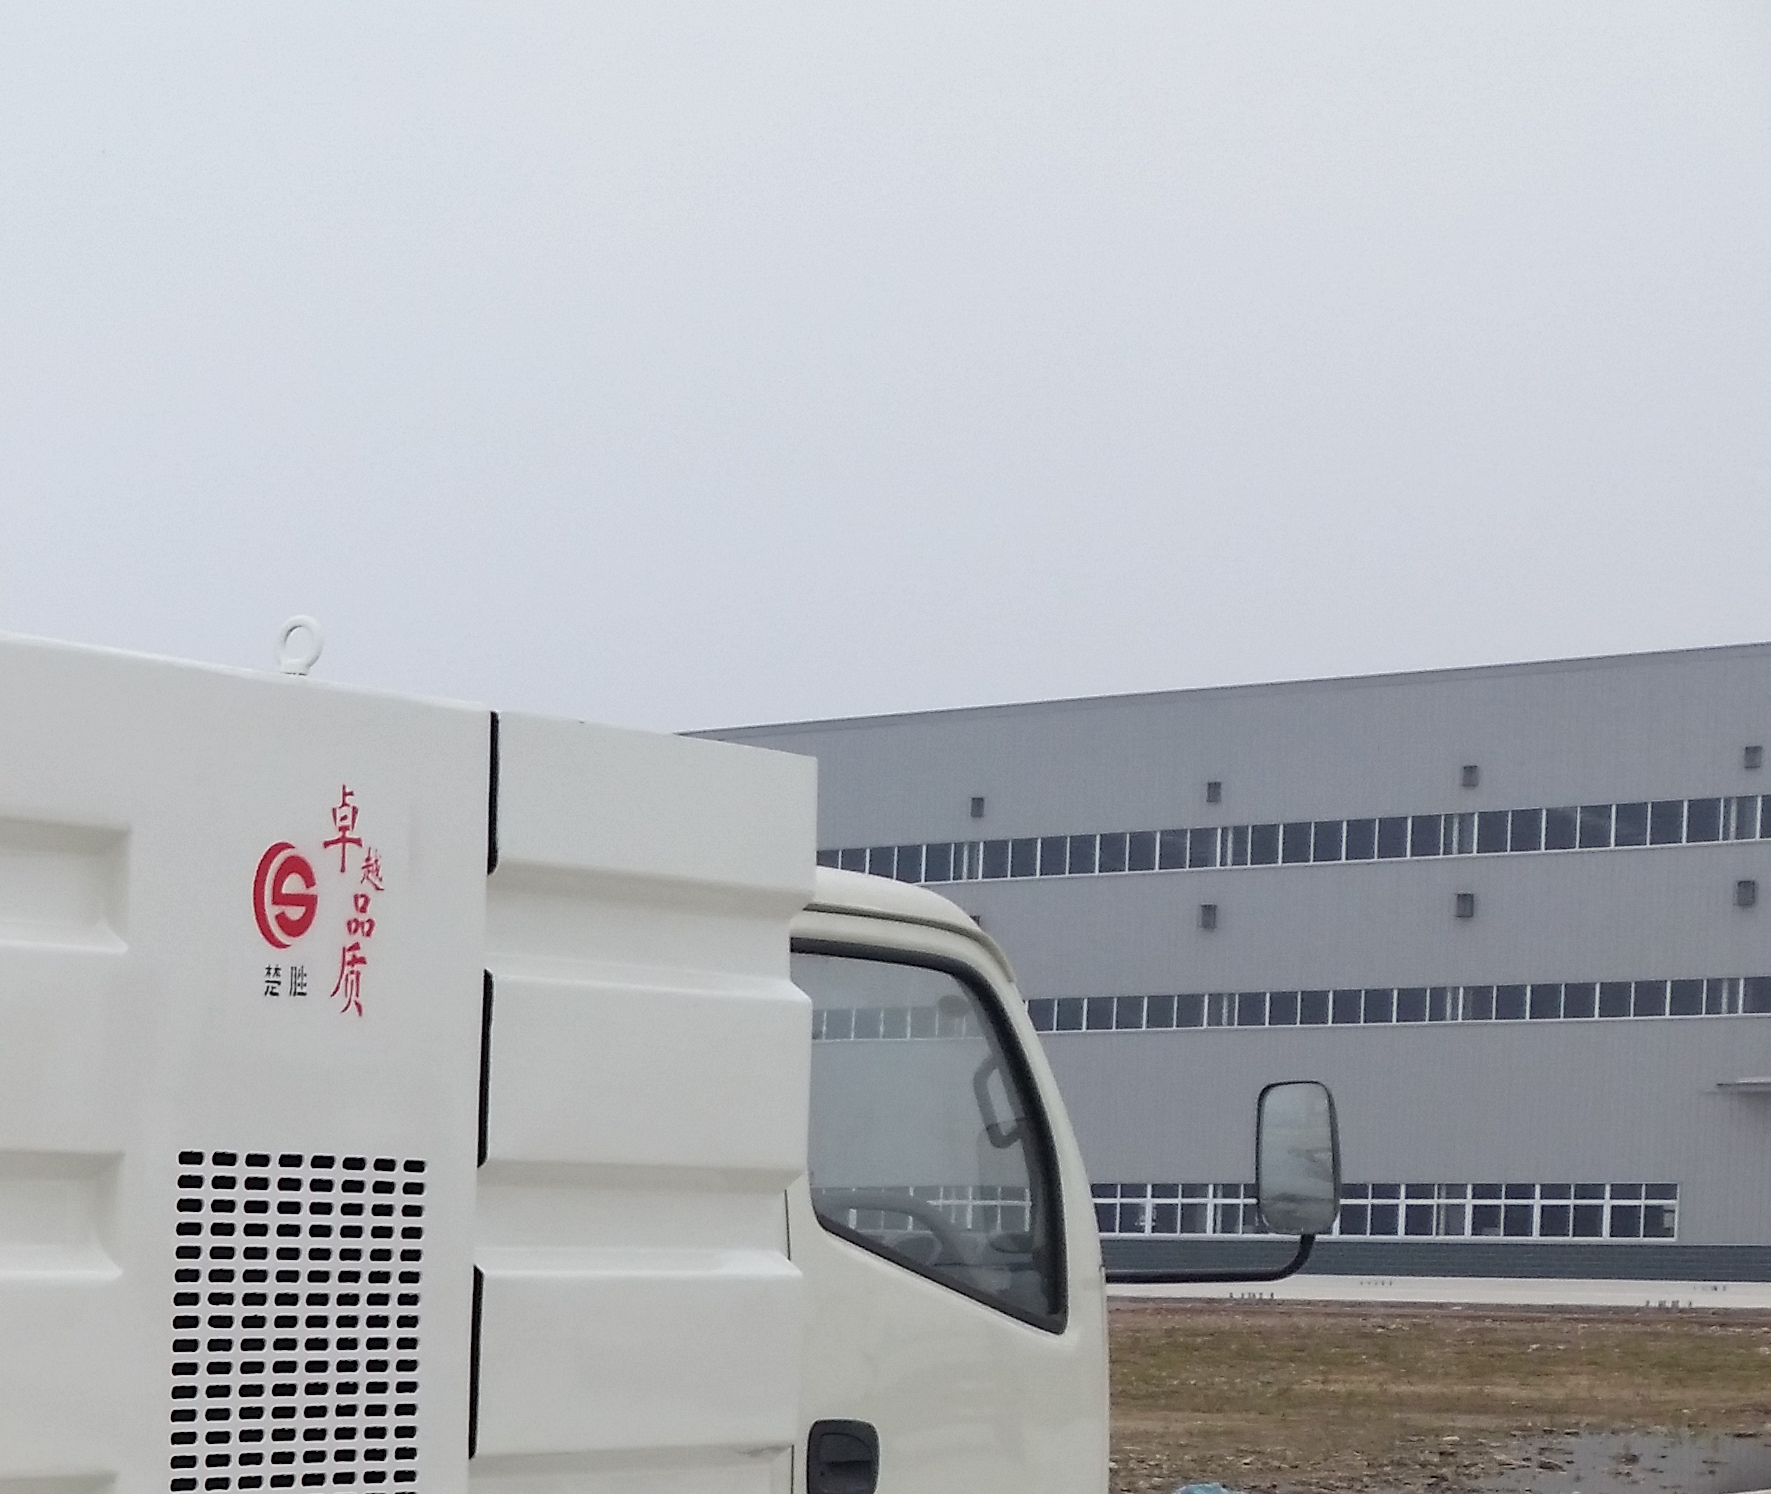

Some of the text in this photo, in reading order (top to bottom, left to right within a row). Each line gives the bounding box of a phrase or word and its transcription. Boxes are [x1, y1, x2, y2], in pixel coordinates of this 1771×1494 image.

[322, 784, 385, 1017] 卓越品质
[264, 964, 308, 997] 楚胜
